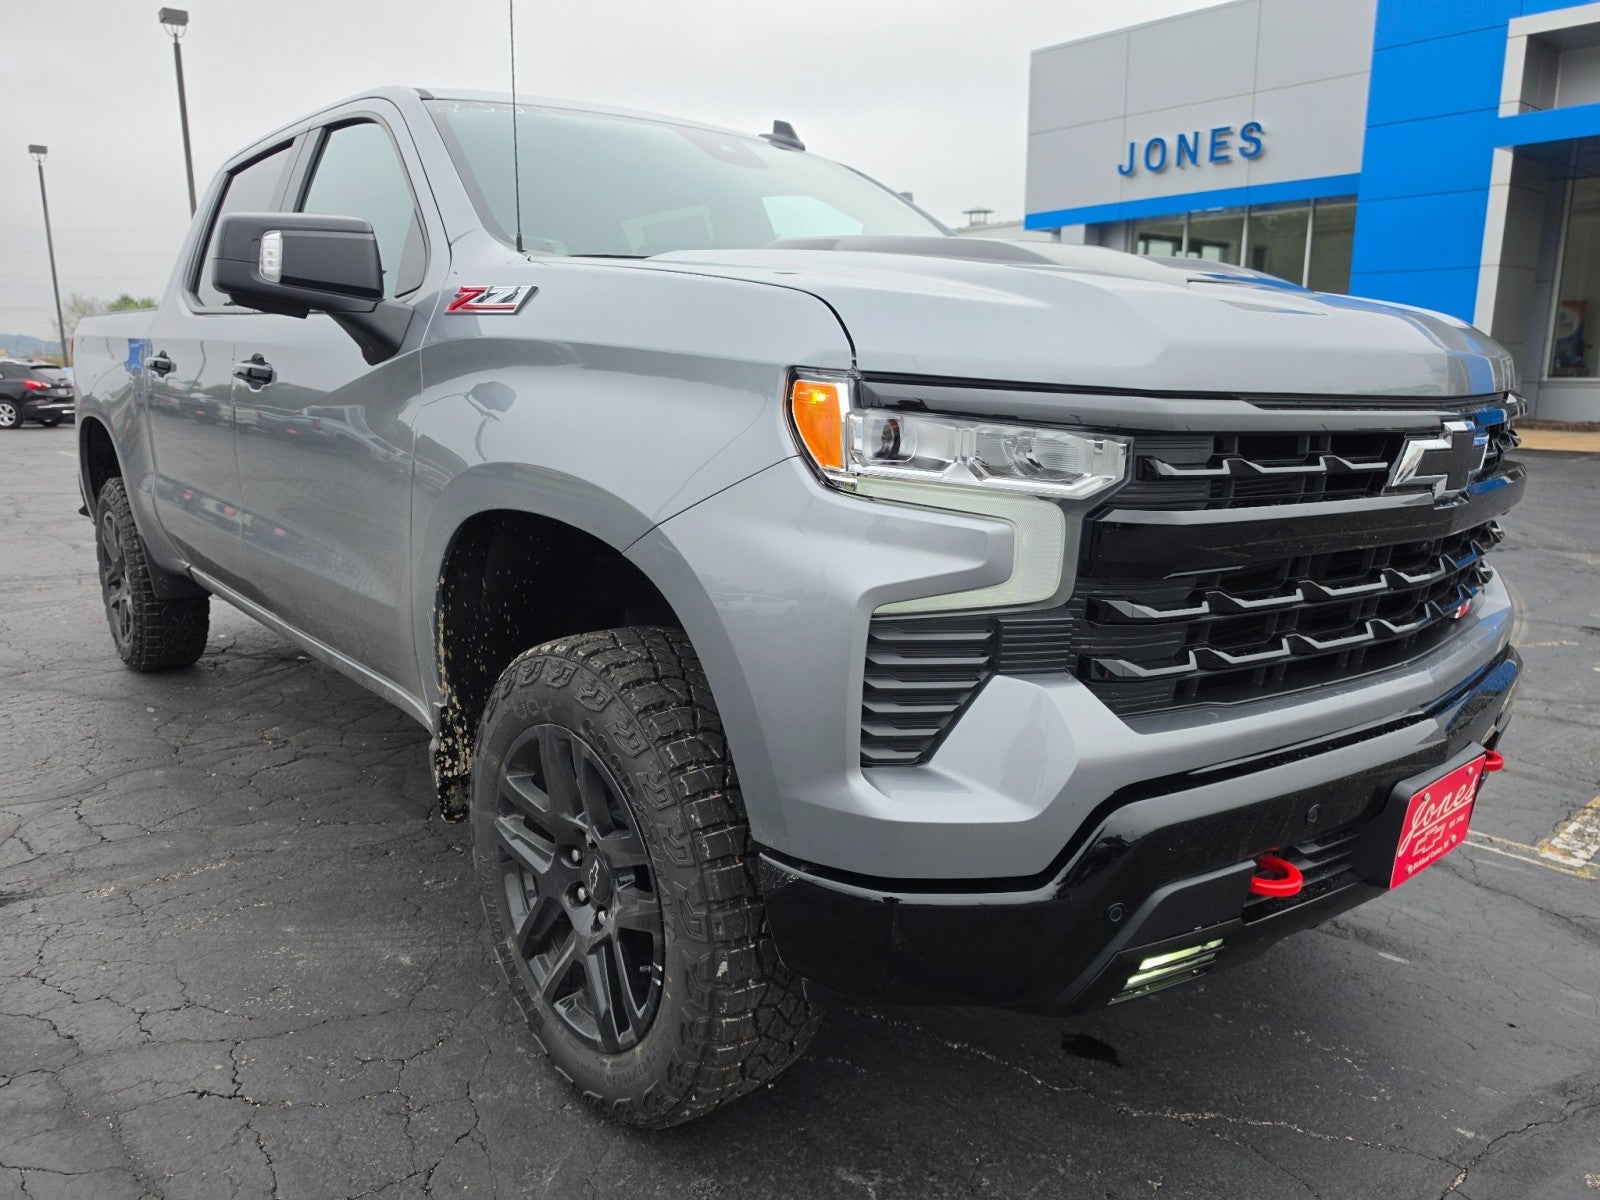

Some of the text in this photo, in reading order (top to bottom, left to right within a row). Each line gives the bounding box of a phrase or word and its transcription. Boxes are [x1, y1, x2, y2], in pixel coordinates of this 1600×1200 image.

[1117, 121, 1265, 177] JONES
[444, 286, 539, 315] Z71
[1397, 774, 1479, 857] Jones
